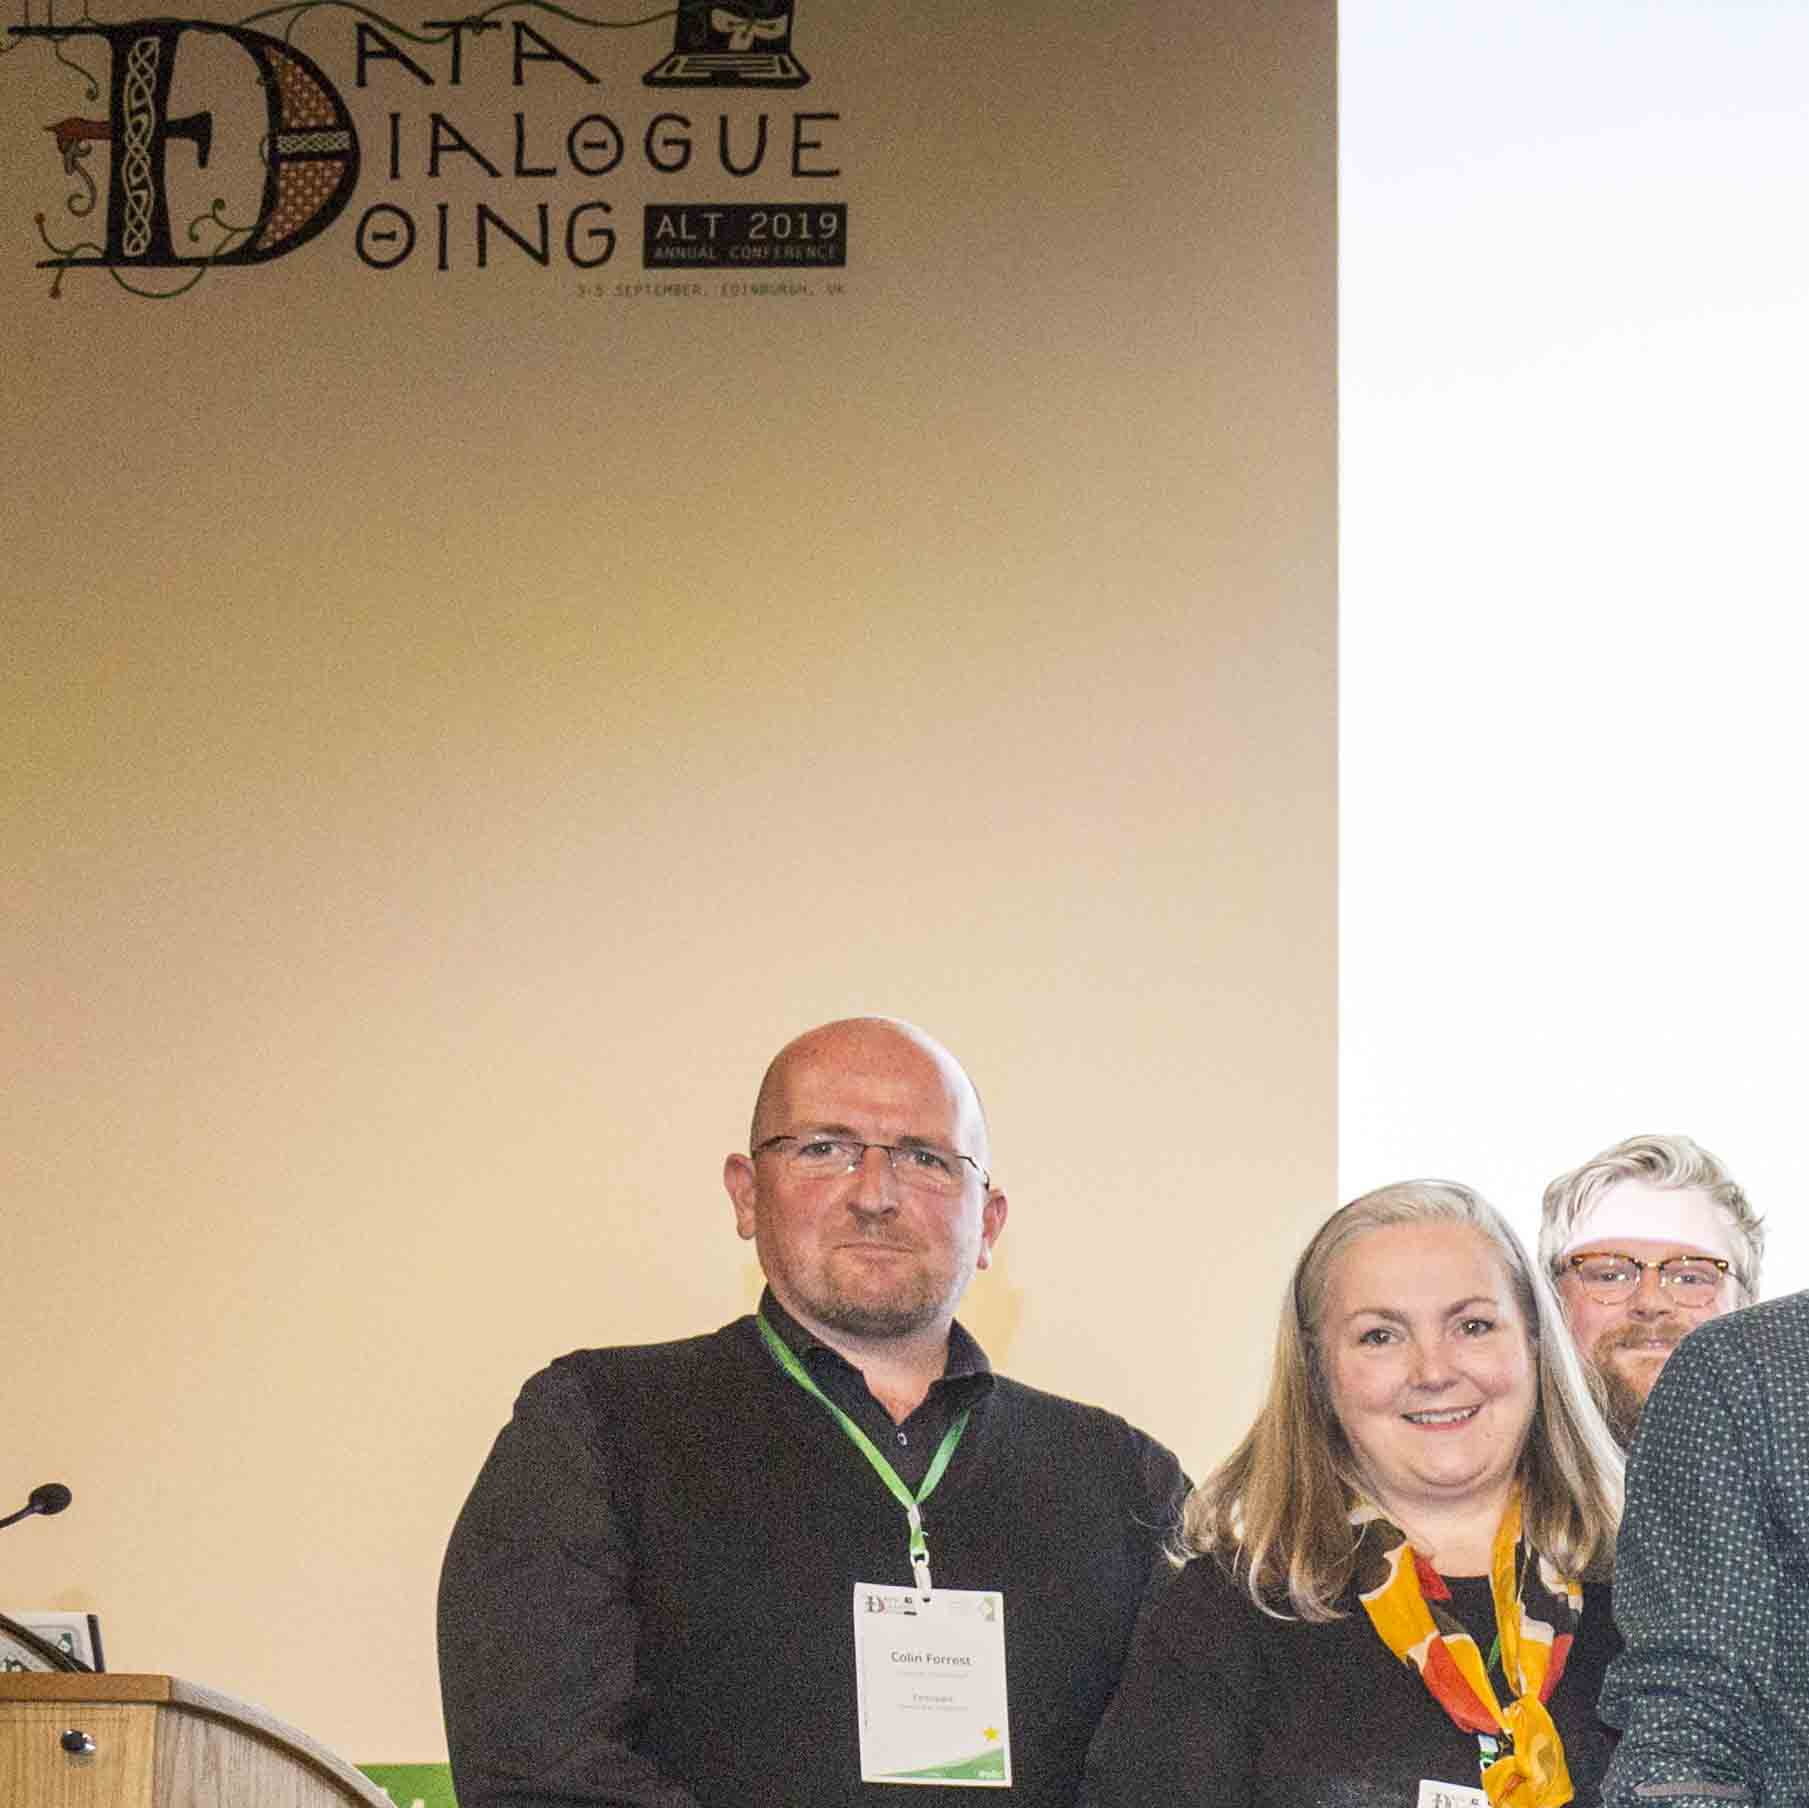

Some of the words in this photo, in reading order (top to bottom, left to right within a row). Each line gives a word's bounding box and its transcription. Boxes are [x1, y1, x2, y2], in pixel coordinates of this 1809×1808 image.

[655, 211, 724, 240] ALT
[748, 211, 839, 240] 2019
[654, 246, 717, 261] ANNUAL
[729, 246, 839, 261] CONFERENCE
[891, 1651, 923, 1664] Colin
